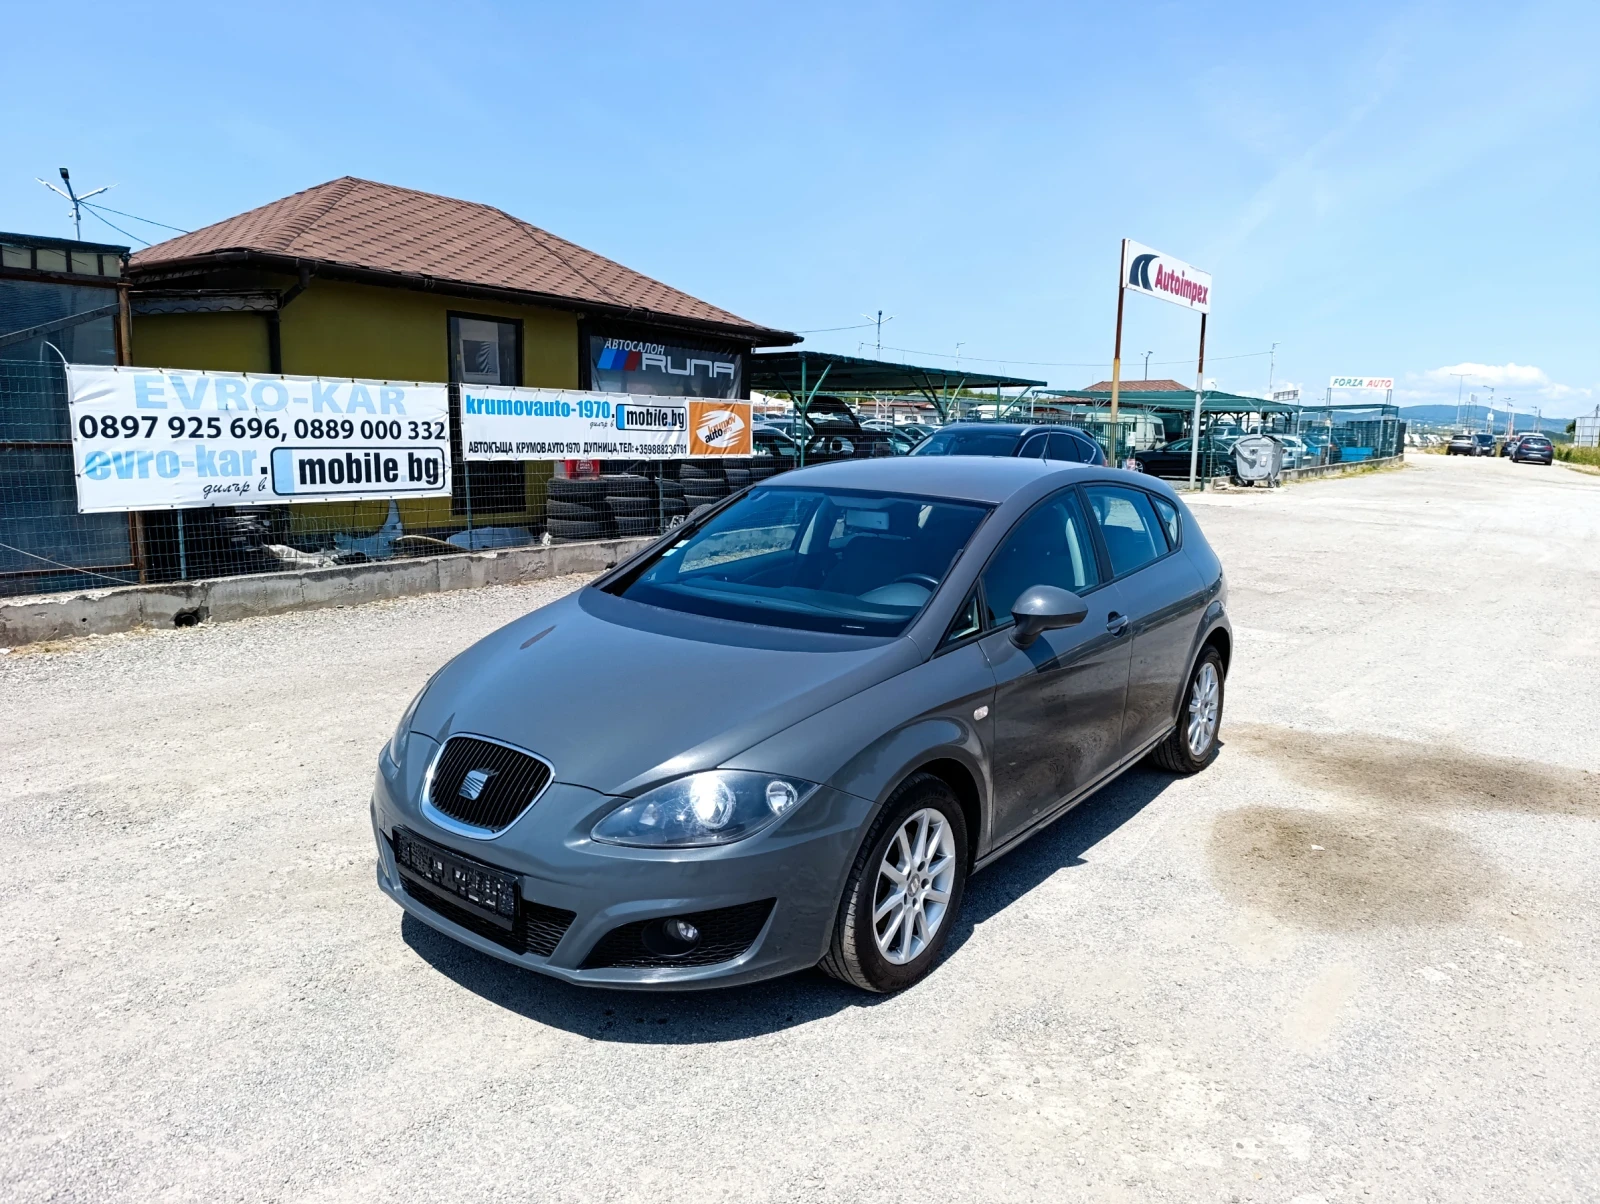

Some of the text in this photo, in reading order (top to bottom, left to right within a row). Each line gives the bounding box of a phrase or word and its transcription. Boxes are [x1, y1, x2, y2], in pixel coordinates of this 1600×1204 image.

[1155, 263, 1208, 306] Autoimpex
[604, 338, 665, 355] АВТОСАЛОН
[641, 352, 735, 379] RUNA
[1332, 378, 1392, 388] FORZA AUTO
[133, 375, 407, 415] EVRO-KAR
[78, 414, 446, 442] 0897 925 696, 0889 000 332
[626, 408, 685, 429] mobile.bg
[704, 428, 723, 444] auto
[468, 441, 513, 455] АВТОКЪЩА
[565, 442, 581, 454] 1970
